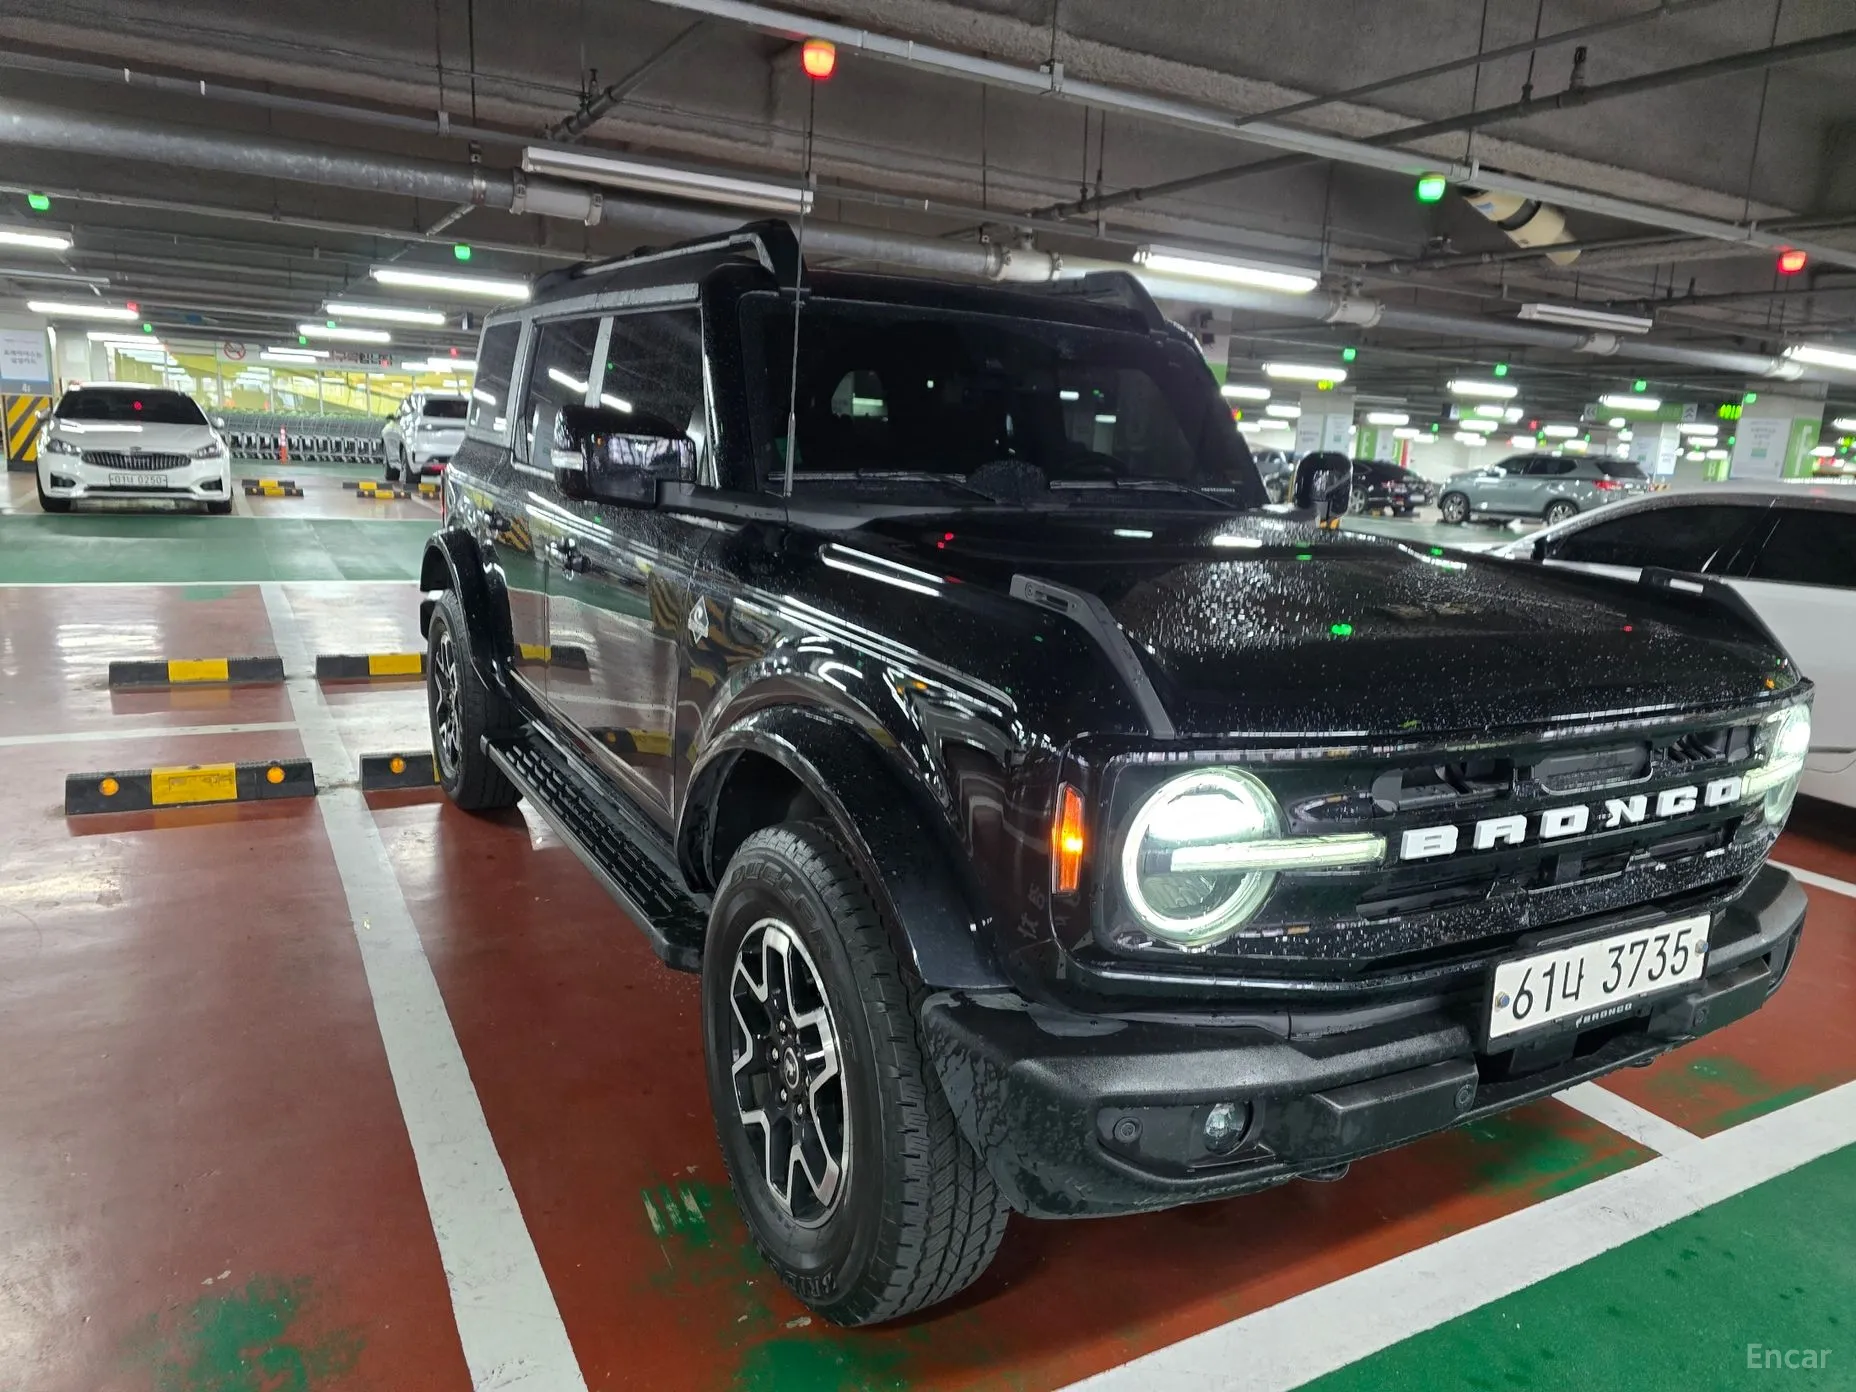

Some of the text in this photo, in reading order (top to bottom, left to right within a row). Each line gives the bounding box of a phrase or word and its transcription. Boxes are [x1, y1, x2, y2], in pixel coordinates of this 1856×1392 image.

[1400, 776, 1742, 860] BRONCO
[1512, 927, 1692, 1020] 61나 3735
[1582, 1002, 1633, 1024] BRONCO
